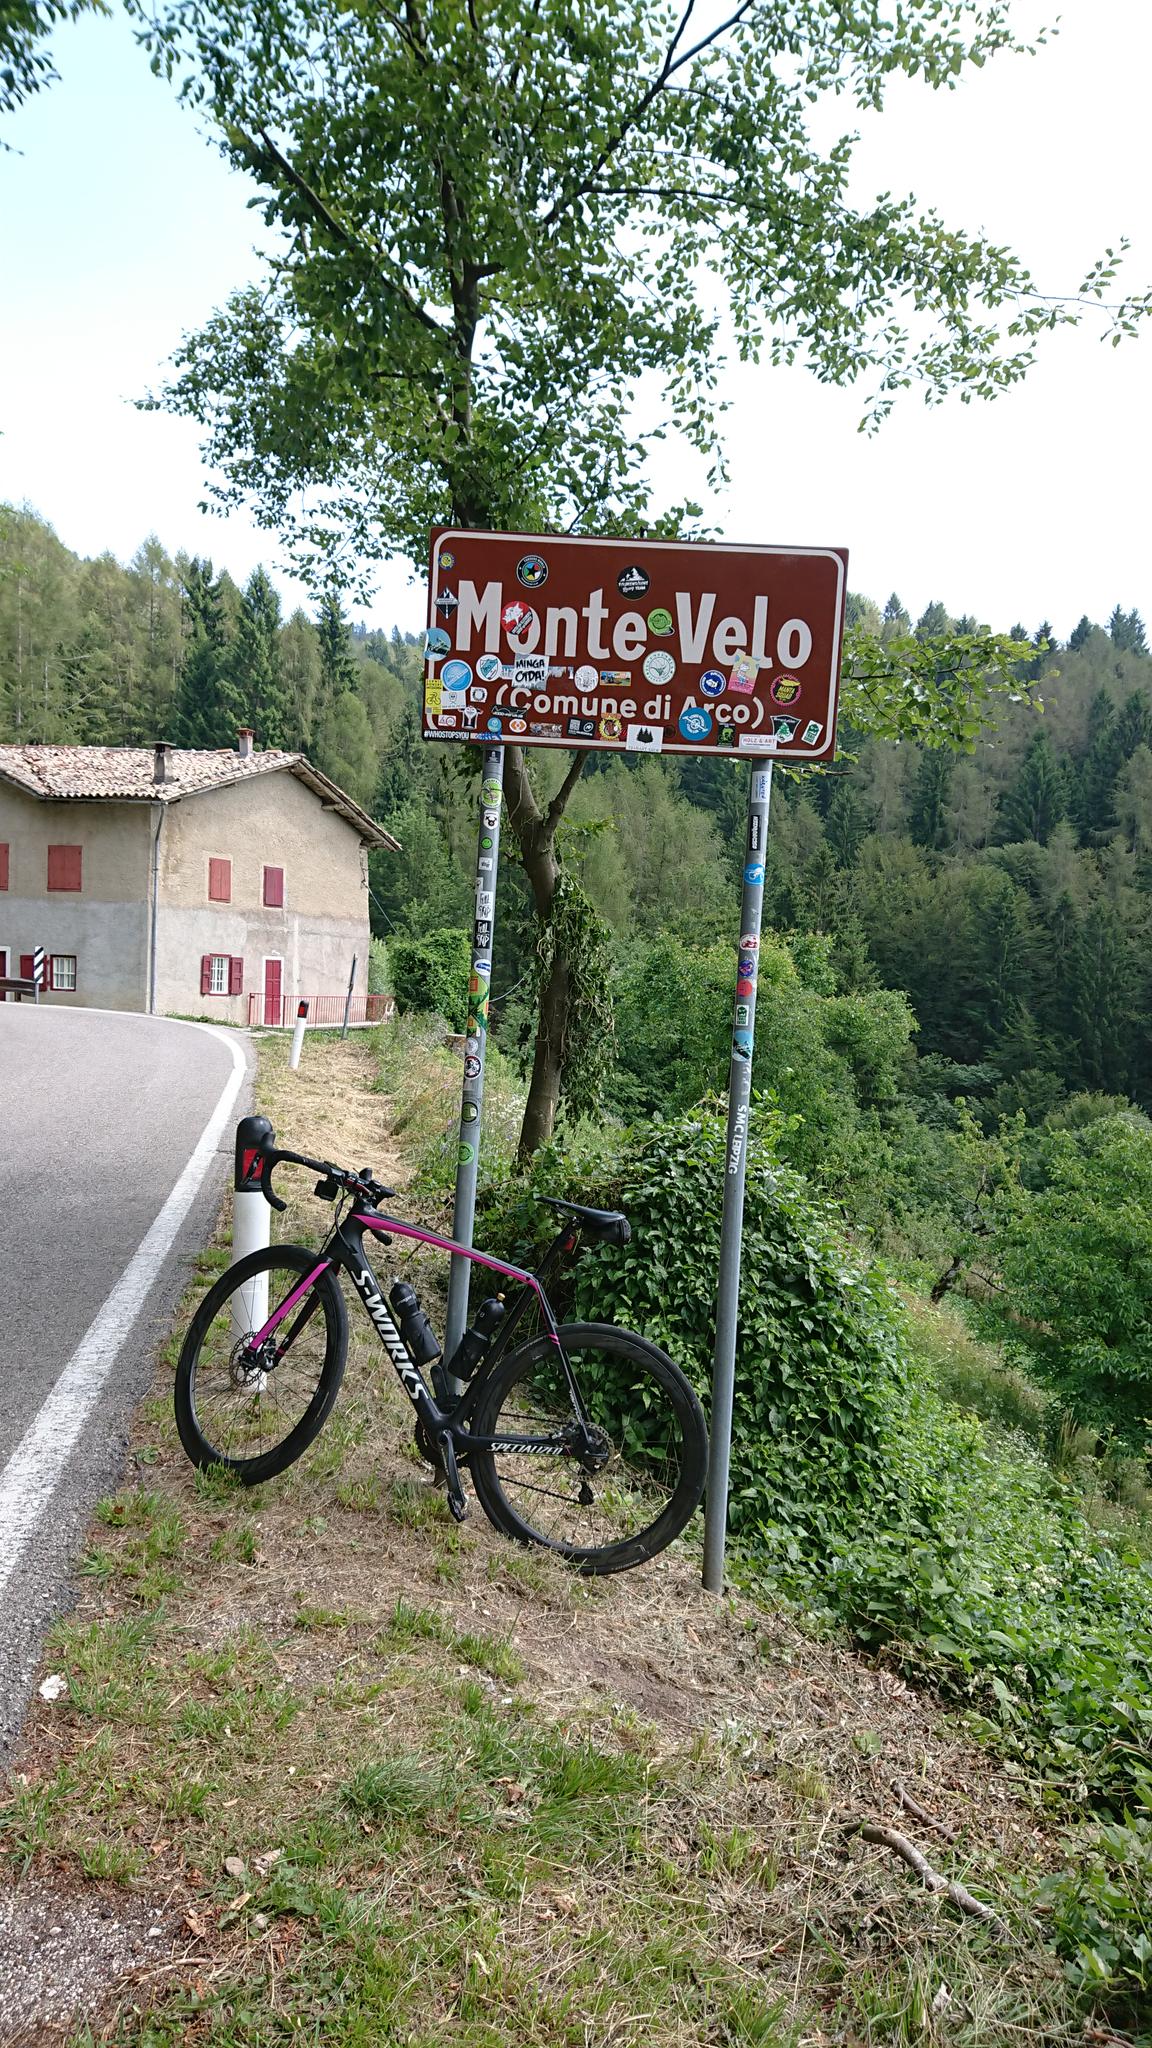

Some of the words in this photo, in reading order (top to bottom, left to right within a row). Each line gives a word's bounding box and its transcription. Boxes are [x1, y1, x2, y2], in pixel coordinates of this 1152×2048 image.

[456, 579, 647, 661] Monte
[675, 592, 812, 669] Velo
[516, 659, 545, 668] MINGA
[643, 694, 672, 720] di
[734, 1104, 747, 1133] SMC
[728, 1134, 744, 1175] LEIPZIG
[351, 1269, 429, 1400] S-WORKS
[487, 1442, 563, 1455] SPECIALIZED
